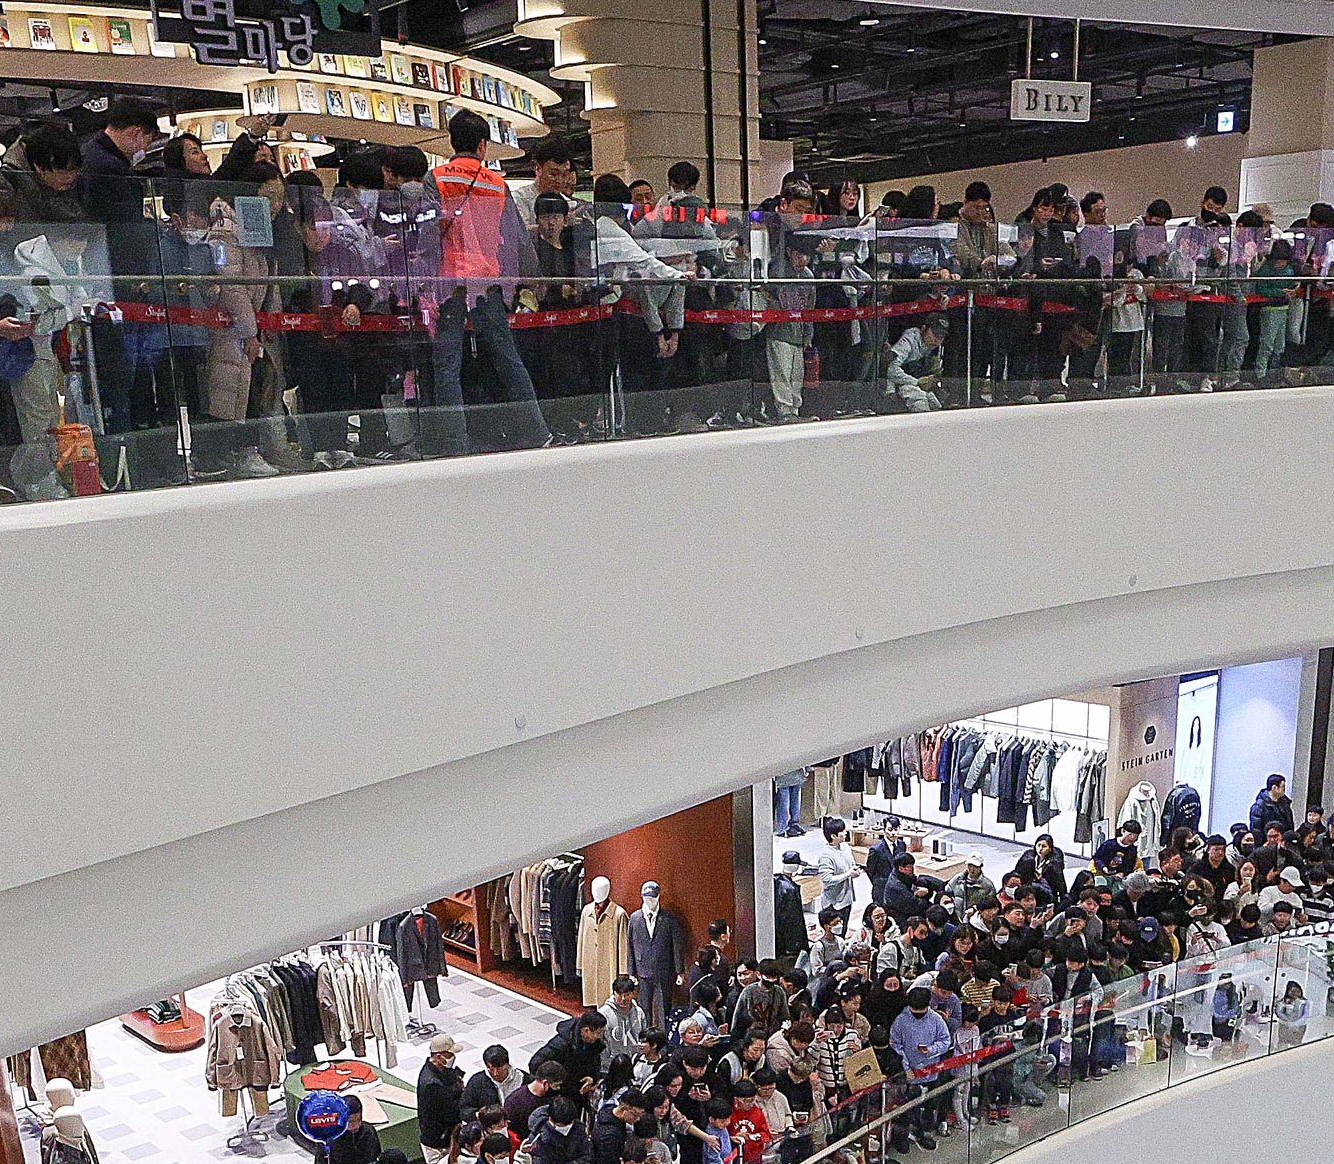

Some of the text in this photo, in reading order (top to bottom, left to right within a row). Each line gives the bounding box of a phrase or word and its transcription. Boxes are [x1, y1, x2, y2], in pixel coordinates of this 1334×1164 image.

[1026, 87, 1085, 115] BILY
[1121, 749, 1173, 771] STEIN GARTEN
